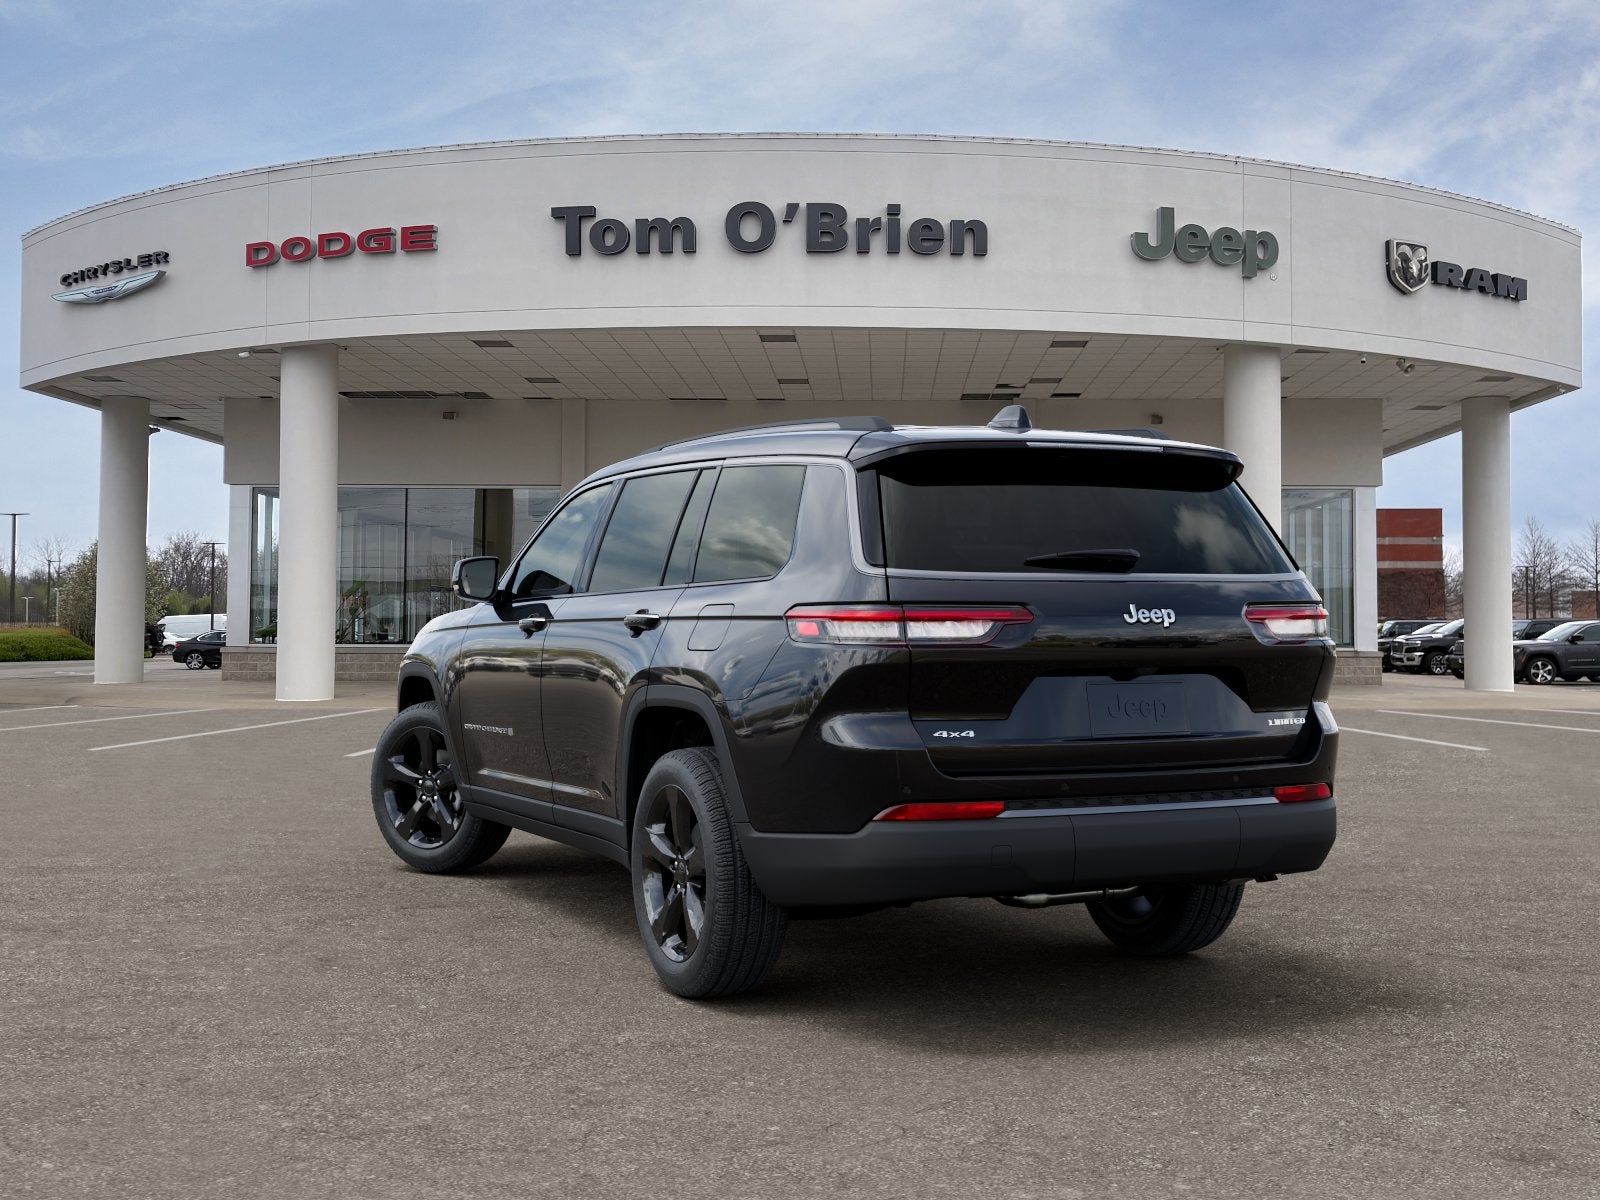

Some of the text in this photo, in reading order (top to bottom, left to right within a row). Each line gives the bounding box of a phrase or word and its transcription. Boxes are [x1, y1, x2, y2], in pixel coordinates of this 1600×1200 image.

[246, 225, 438, 268] DODGE
[551, 201, 989, 256] Tom O'Brien
[1131, 207, 1279, 278] Jeep
[60, 251, 170, 287] CHRYSLER
[1431, 261, 1527, 301] RAM
[1123, 603, 1176, 628] Jeep
[1107, 693, 1167, 723] Jeep
[932, 729, 976, 739] 4x4
